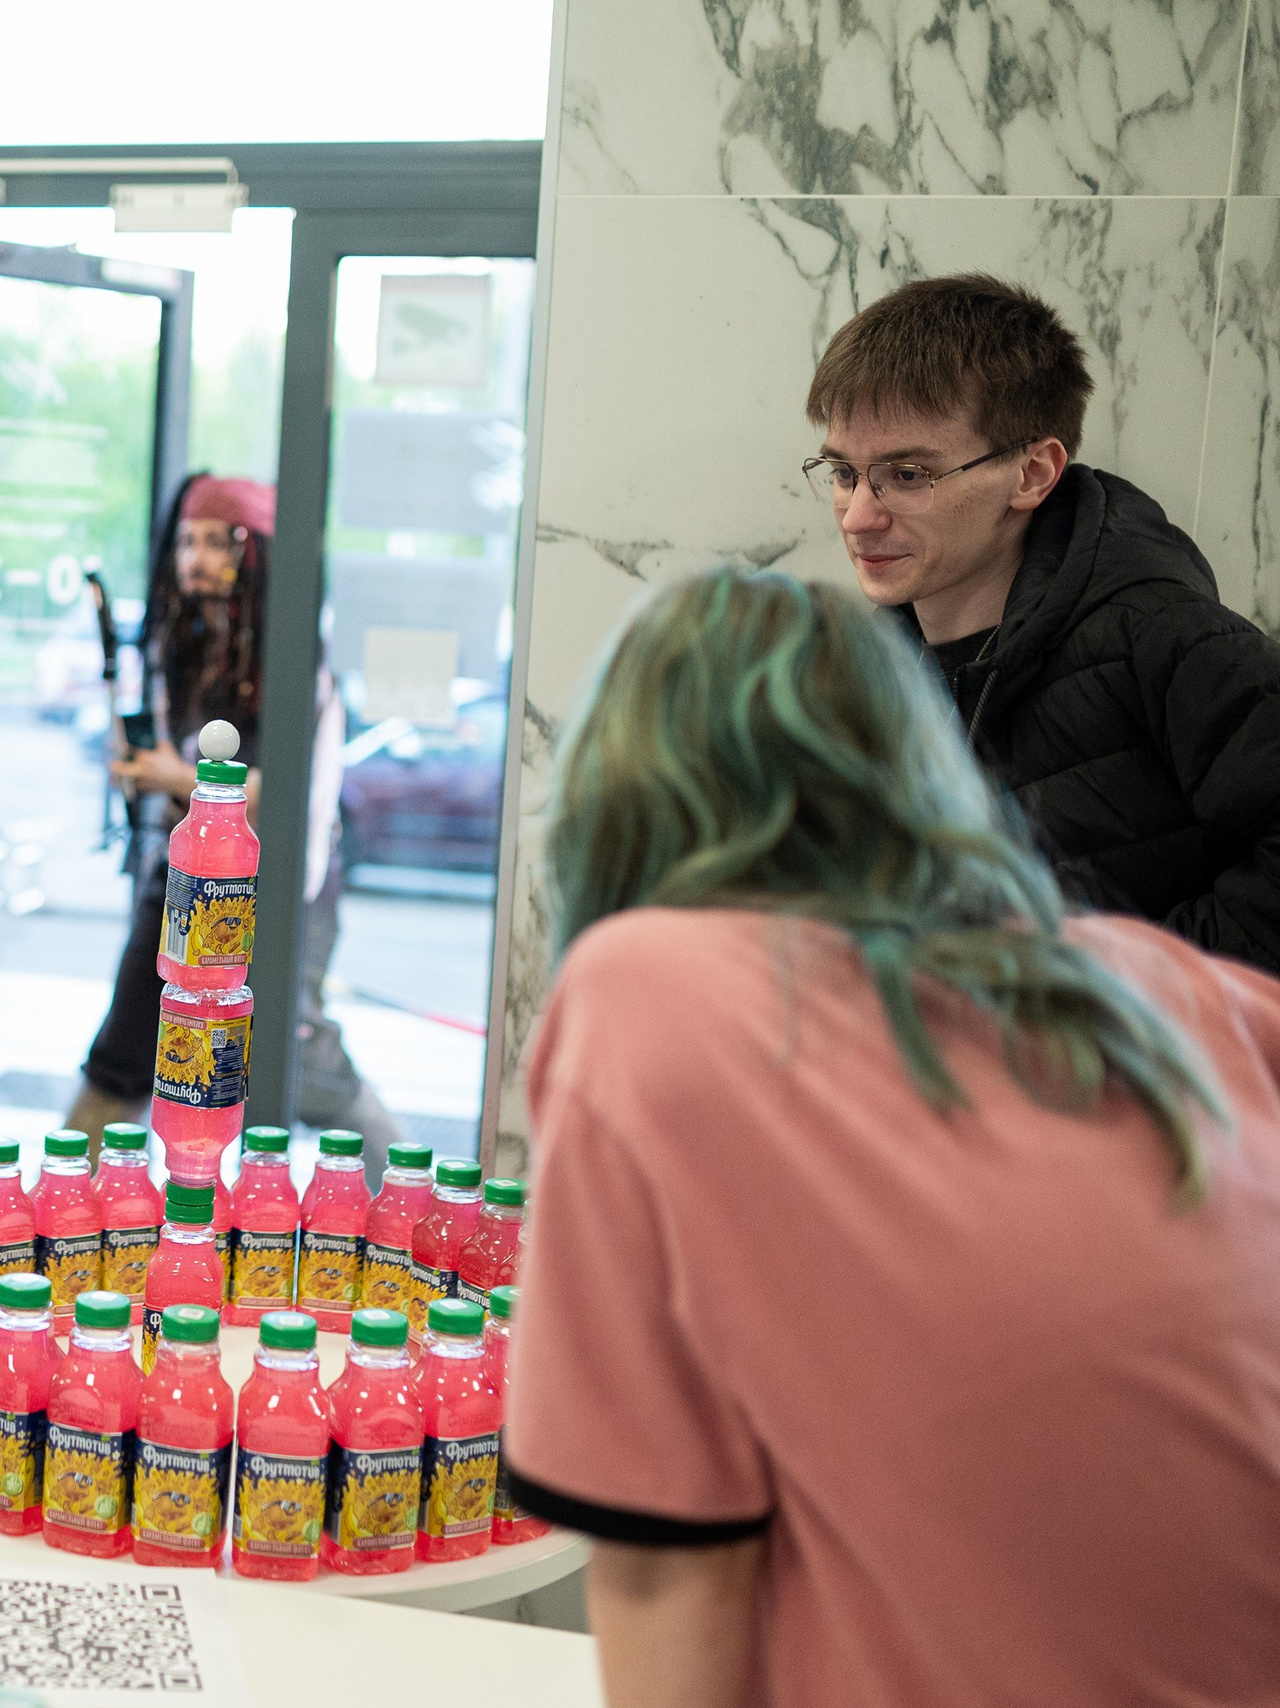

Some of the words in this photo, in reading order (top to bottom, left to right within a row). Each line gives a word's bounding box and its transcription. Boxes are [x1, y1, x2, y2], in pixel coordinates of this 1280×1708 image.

[204, 881, 254, 898] Фрутмотив
[49, 1425, 111, 1455] Фрутмотив
[143, 1444, 210, 1472] Фрутмотив
[250, 1455, 320, 1479] Фрутмотив
